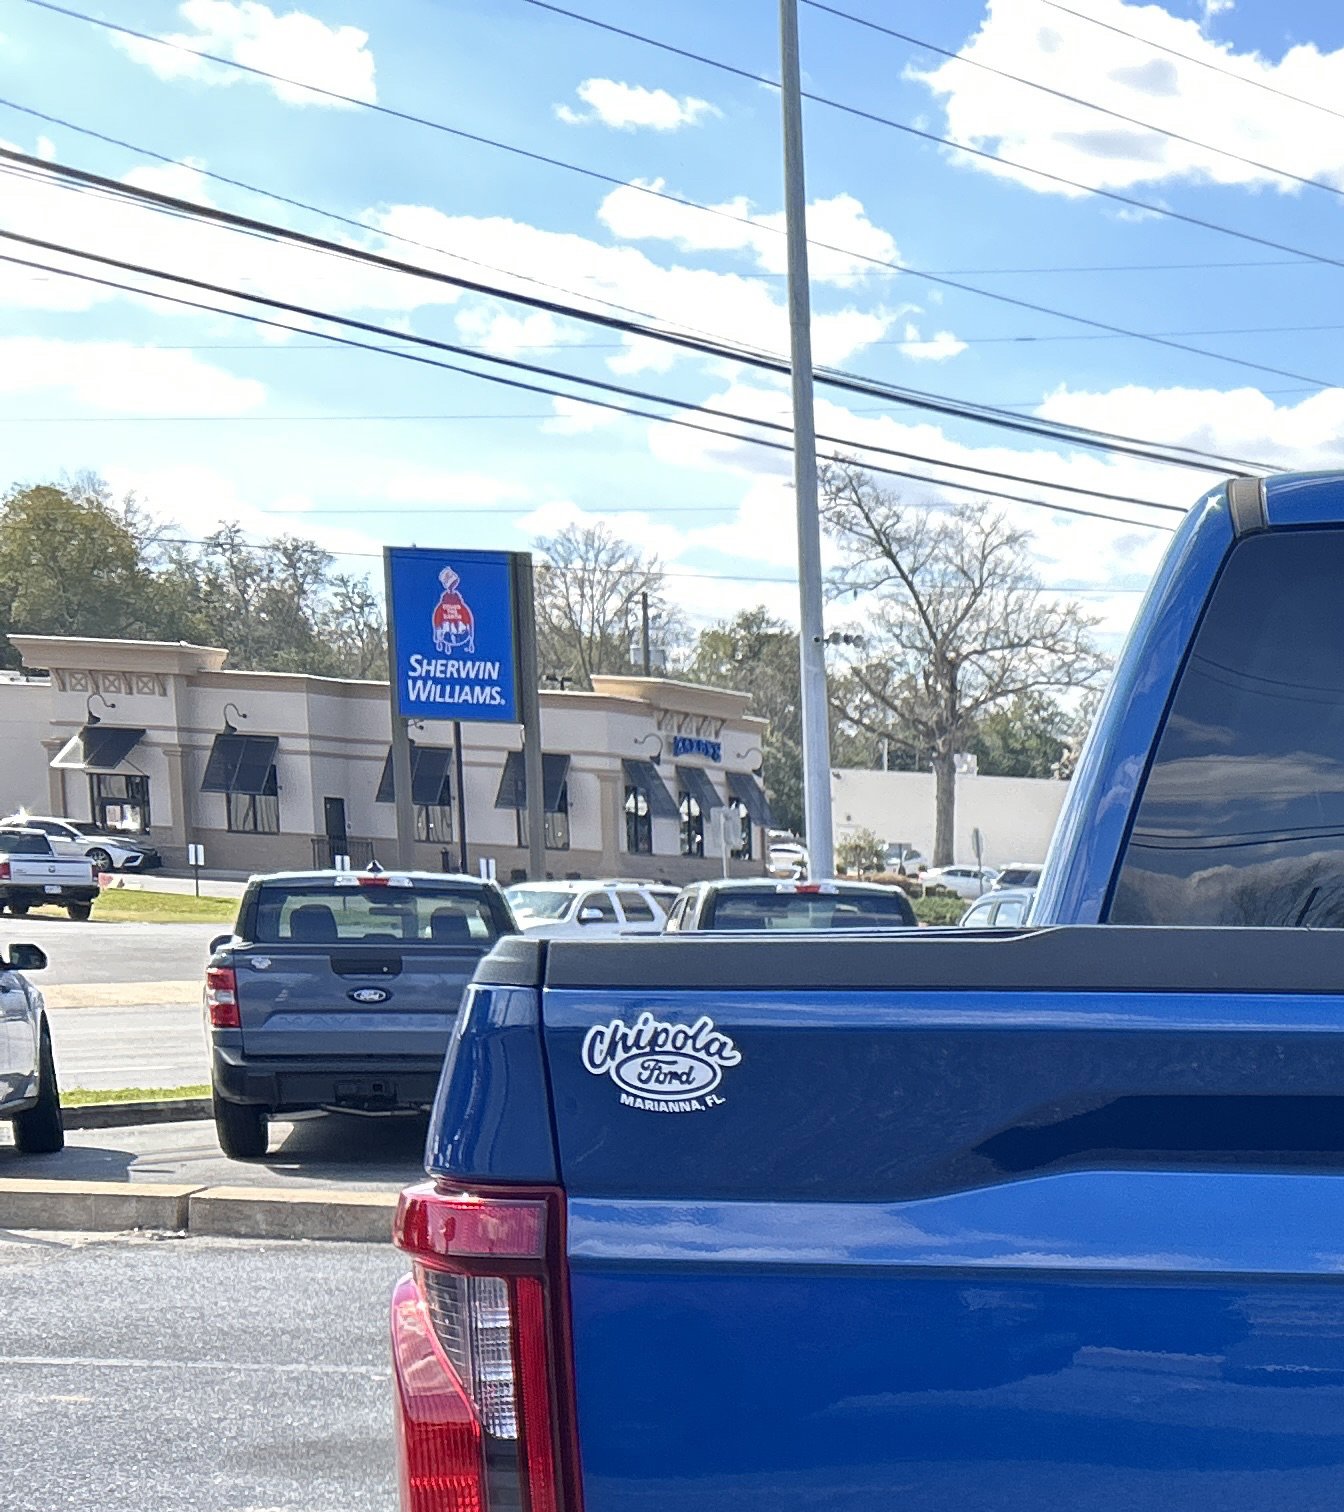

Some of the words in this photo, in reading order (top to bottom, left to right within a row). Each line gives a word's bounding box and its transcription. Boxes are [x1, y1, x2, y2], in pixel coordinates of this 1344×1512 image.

[408, 654, 500, 680] SHERWIN
[585, 1014, 739, 1071] Chipola
[637, 1059, 696, 1085] Ford
[620, 1093, 706, 1112] MARIANNA,
